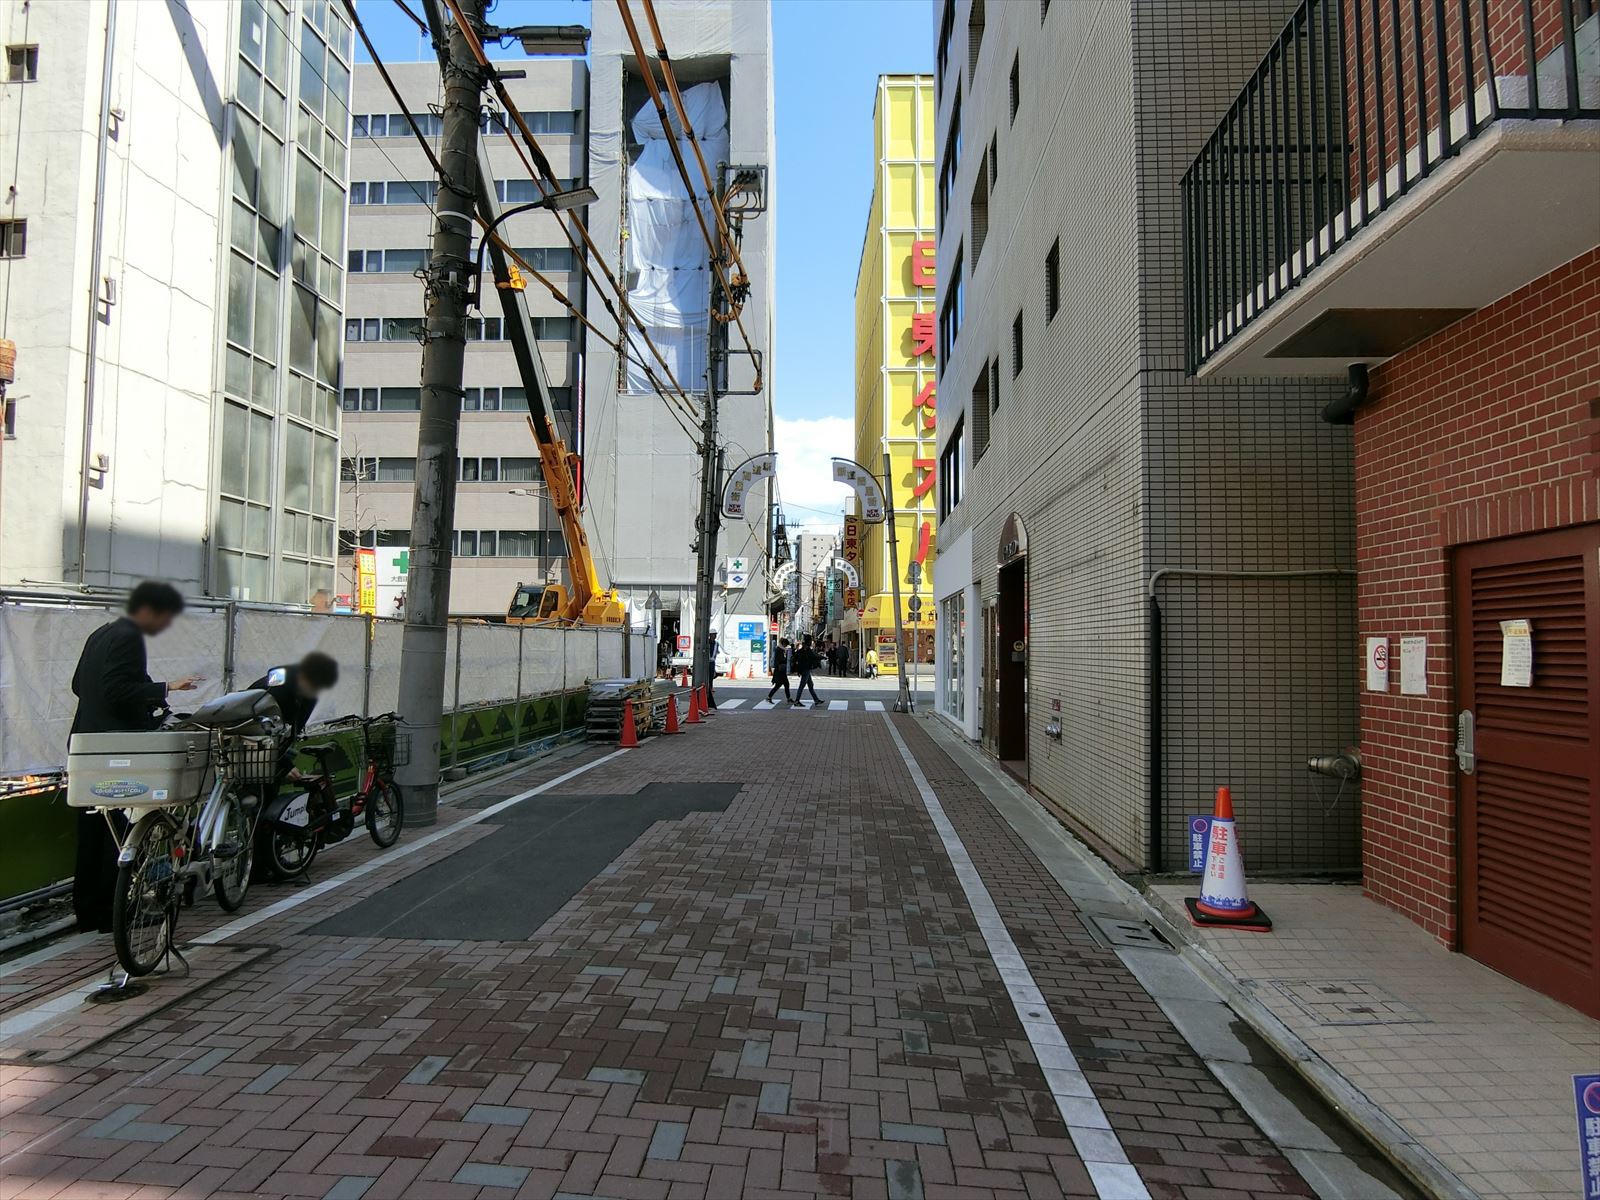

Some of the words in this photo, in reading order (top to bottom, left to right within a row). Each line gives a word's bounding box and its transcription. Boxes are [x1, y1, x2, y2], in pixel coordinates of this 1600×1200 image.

[1192, 833, 1203, 868] 駐車禁止
[1211, 825, 1228, 856] 駐車
